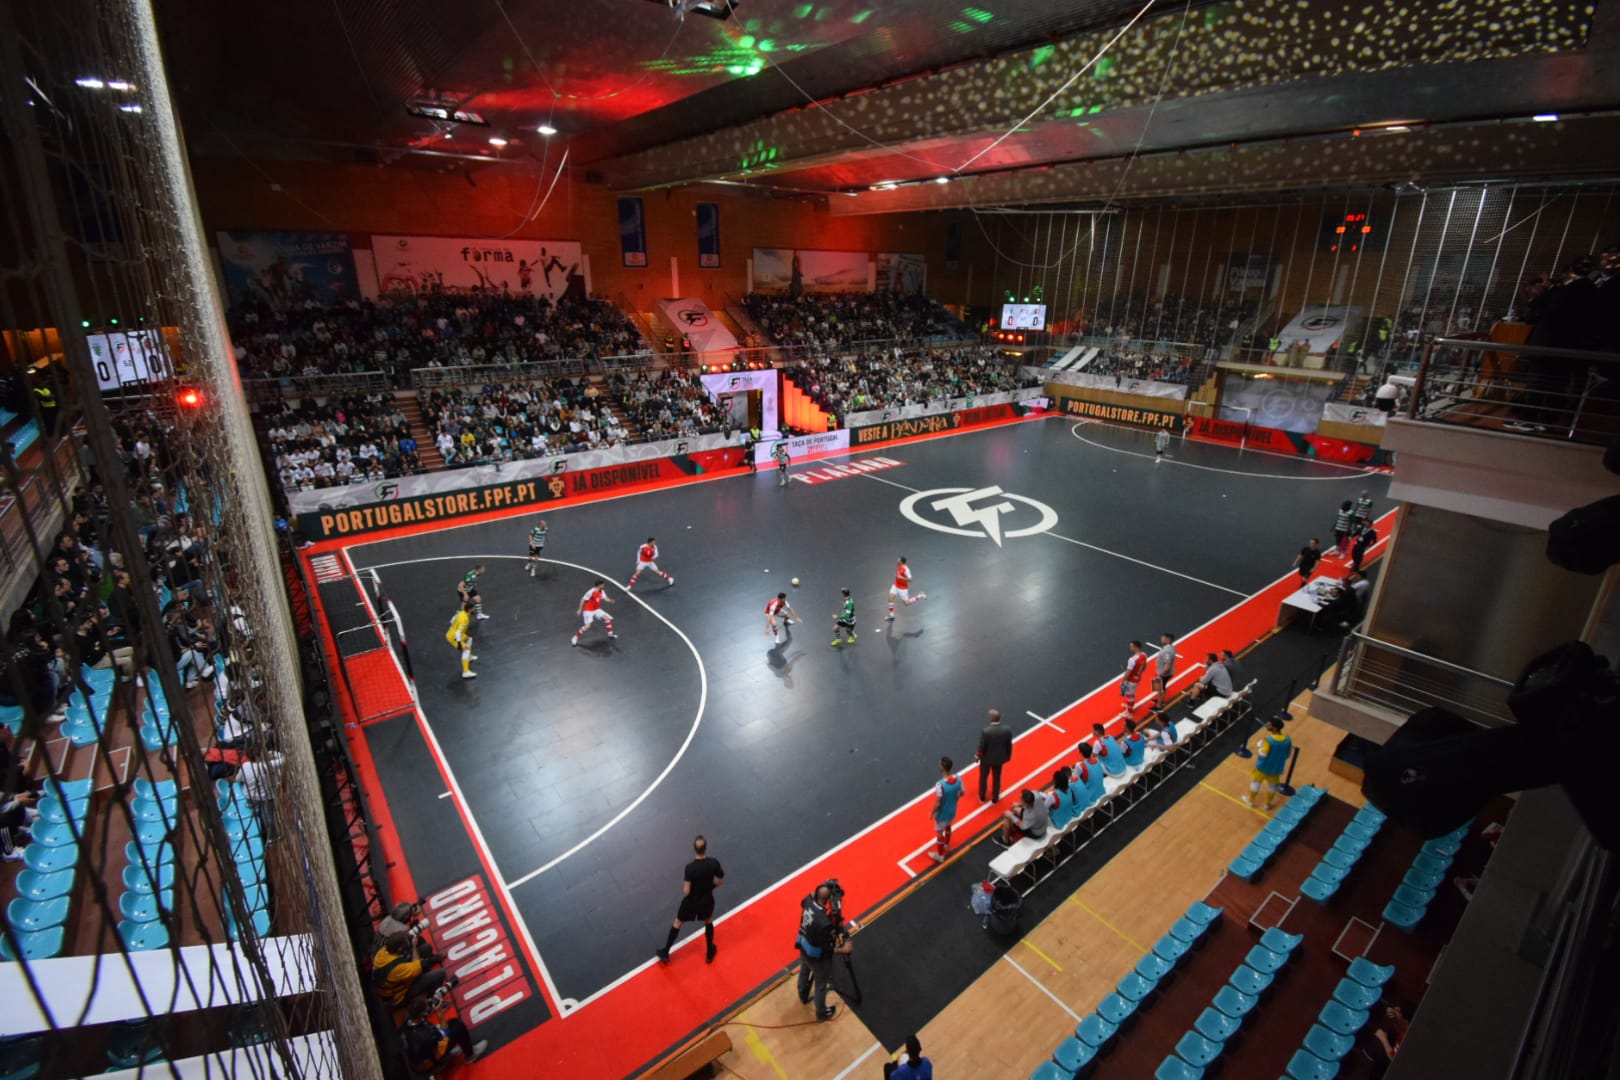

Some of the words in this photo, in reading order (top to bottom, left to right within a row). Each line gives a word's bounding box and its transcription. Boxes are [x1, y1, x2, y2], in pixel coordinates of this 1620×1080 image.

[97, 361, 111, 382] 0
[1067, 400, 1176, 429] PORTUGALSTORE.FPF.PT
[858, 427, 882, 442] VESTE
[590, 461, 662, 490] DISPONÍVEL
[320, 482, 537, 536] PORTUGALSTORE.FPF.PT
[429, 880, 524, 1024] PLACARD
